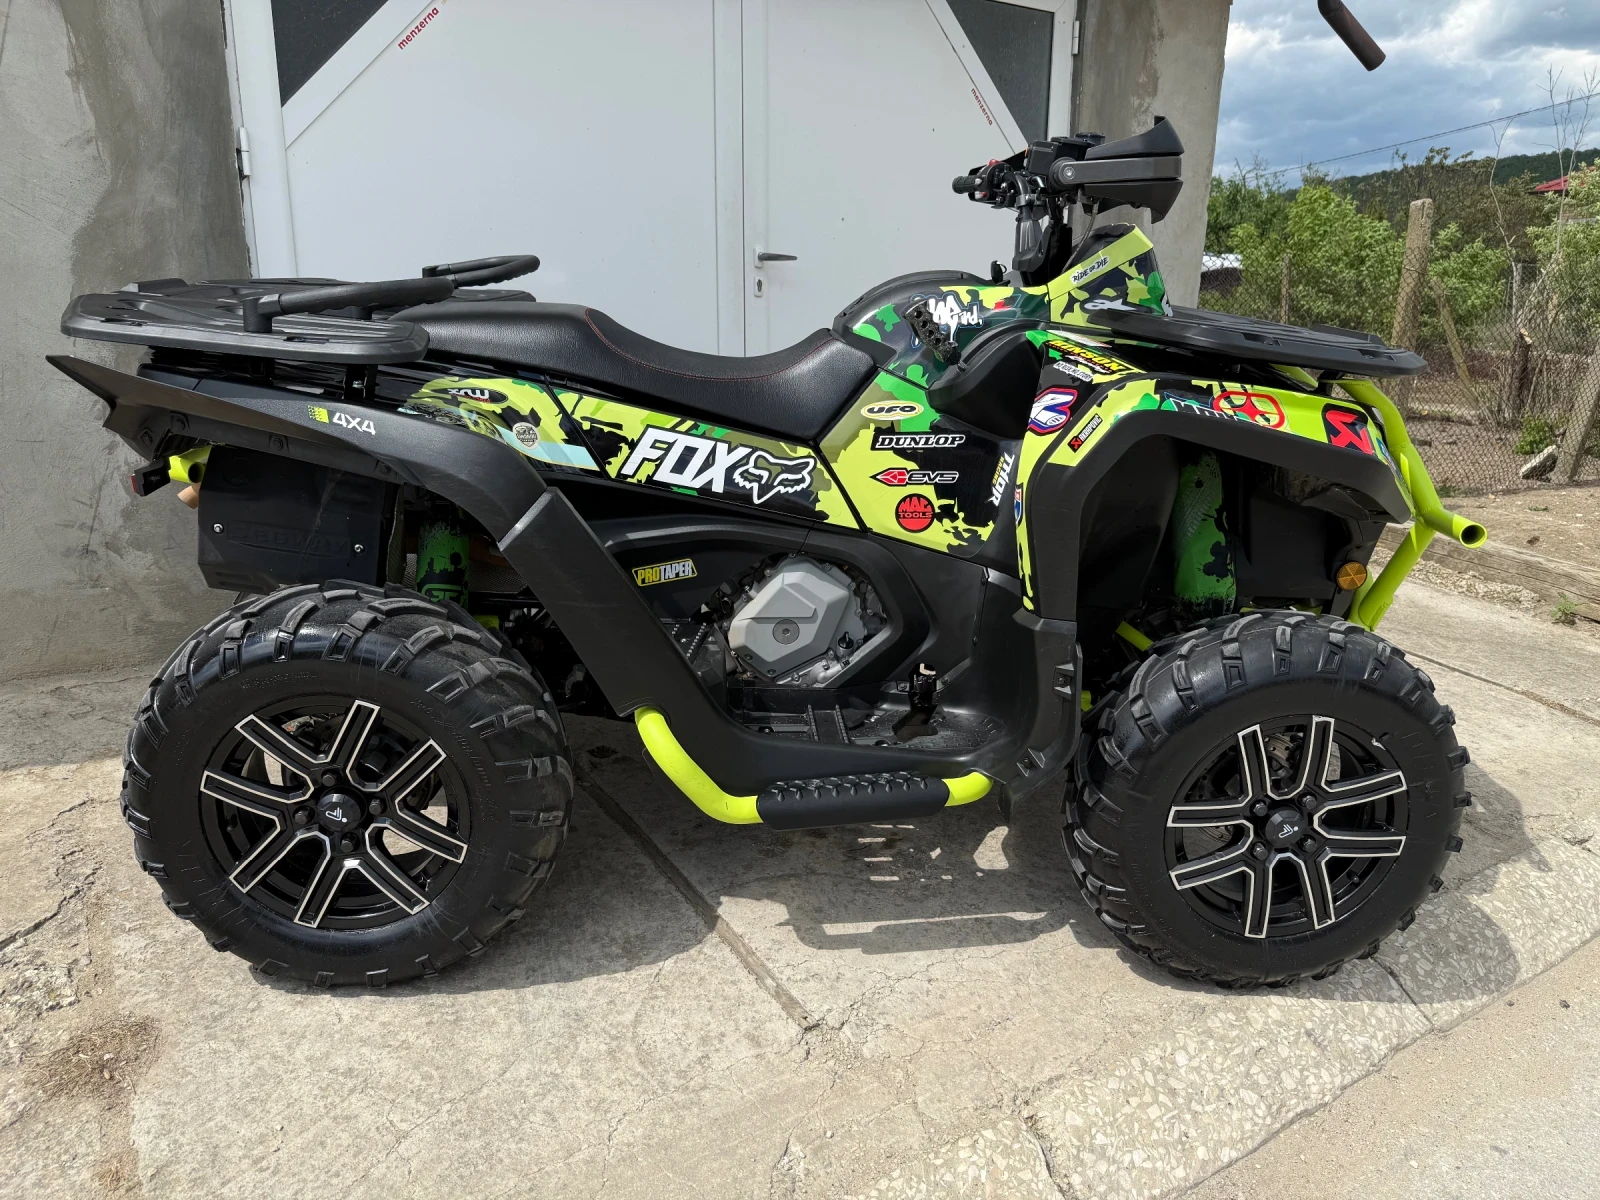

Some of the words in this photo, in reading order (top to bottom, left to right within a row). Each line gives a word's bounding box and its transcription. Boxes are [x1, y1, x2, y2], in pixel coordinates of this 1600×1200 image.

[398, 7, 439, 50] menzerna
[971, 88, 993, 126] menzerna
[866, 405, 917, 414] UFO
[332, 411, 376, 435] 4X4
[875, 434, 966, 449] DUNLOP
[620, 427, 746, 493] FOX
[992, 456, 1005, 485] RACING
[987, 452, 1015, 507] THOR
[898, 497, 933, 513] MAC
[898, 511, 933, 519] TOOLS
